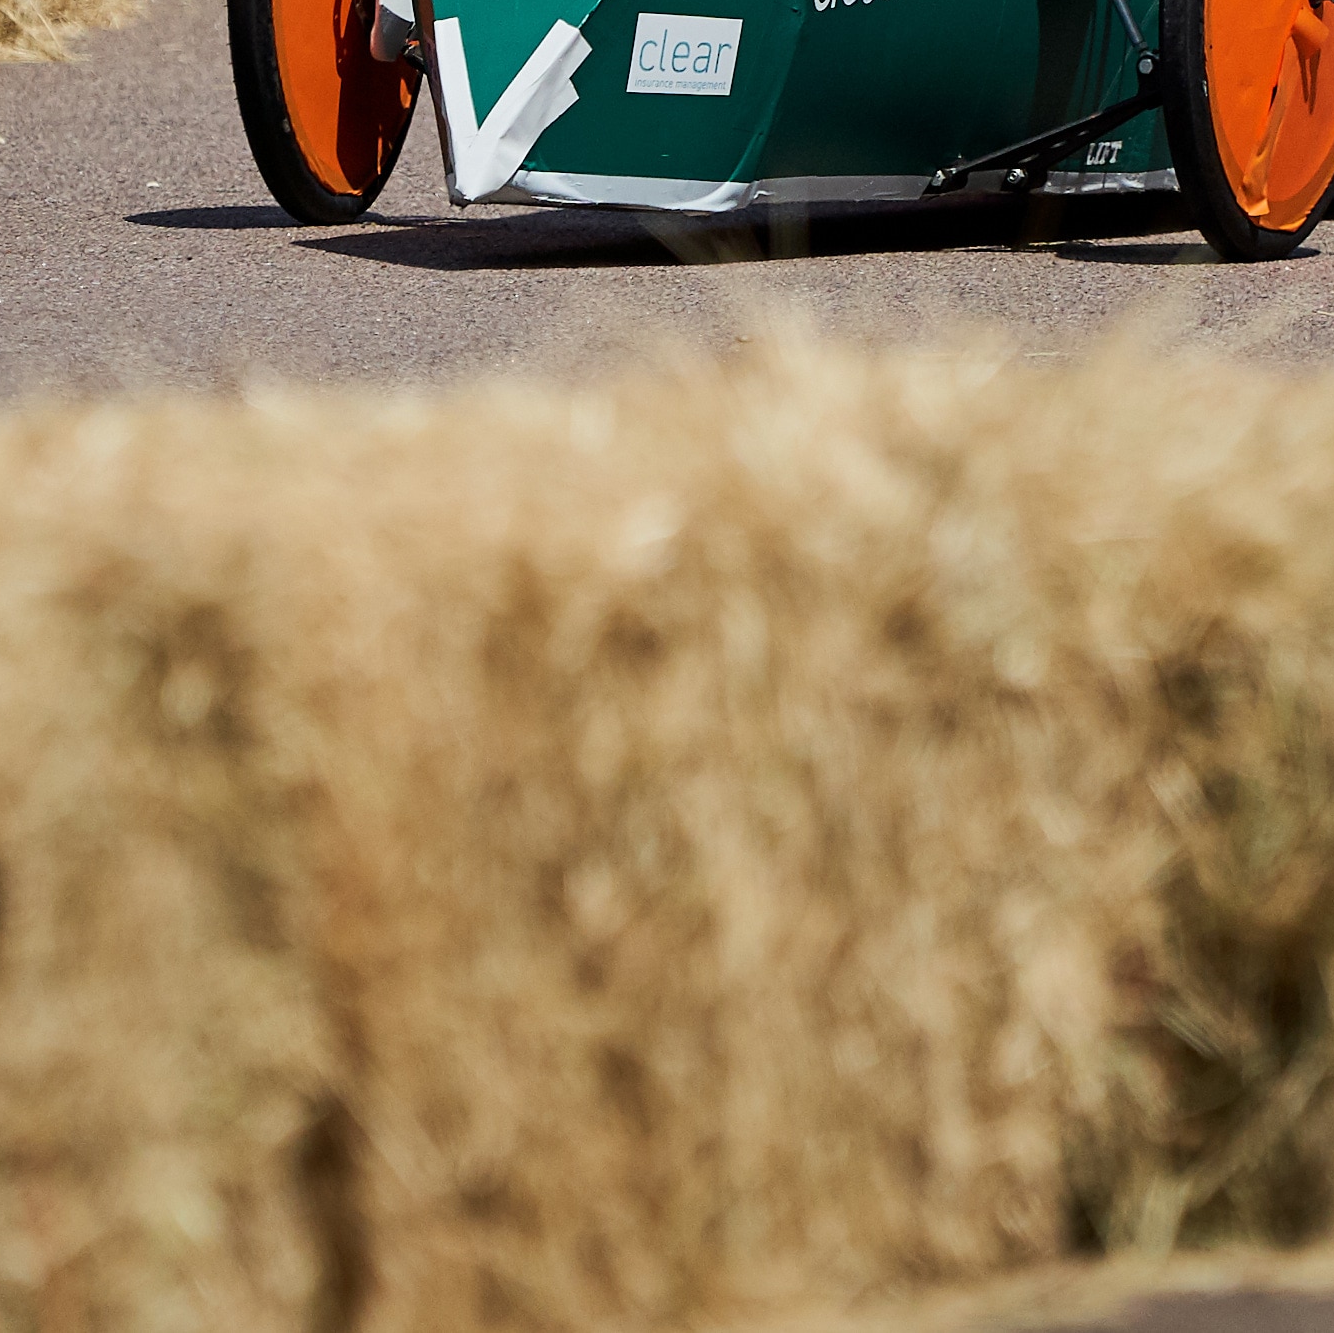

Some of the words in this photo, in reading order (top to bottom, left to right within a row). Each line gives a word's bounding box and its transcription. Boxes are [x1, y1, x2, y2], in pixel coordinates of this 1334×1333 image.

[639, 29, 732, 74] clear
[634, 78, 674, 89] insurance
[675, 80, 727, 92] management
[1085, 140, 1123, 165] LIFT
